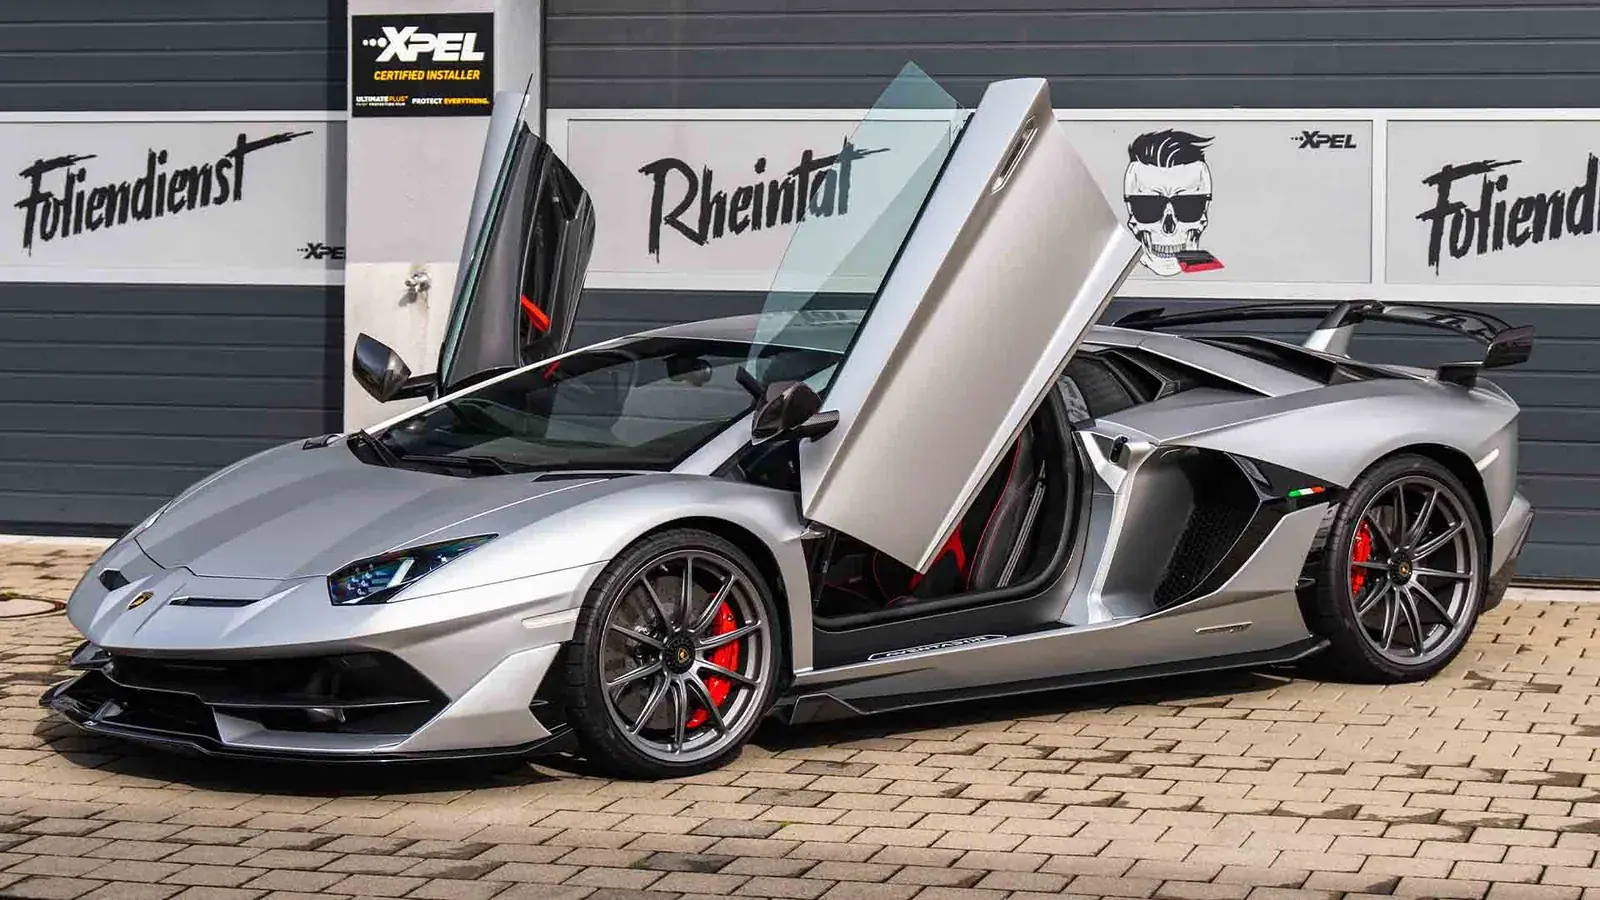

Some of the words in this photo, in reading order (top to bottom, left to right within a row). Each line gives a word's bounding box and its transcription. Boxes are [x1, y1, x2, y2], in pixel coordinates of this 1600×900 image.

[375, 26, 485, 62] XPEL
[374, 70, 425, 81] CERTIFIED
[426, 69, 481, 80] INSTALLER
[411, 97, 442, 105] PROTECT
[1298, 130, 1357, 149] XPEL
[14, 132, 314, 257] Foliendienst
[638, 135, 891, 264] Rheintal
[1415, 152, 1600, 276] Foliend
[303, 242, 346, 260] XPE
